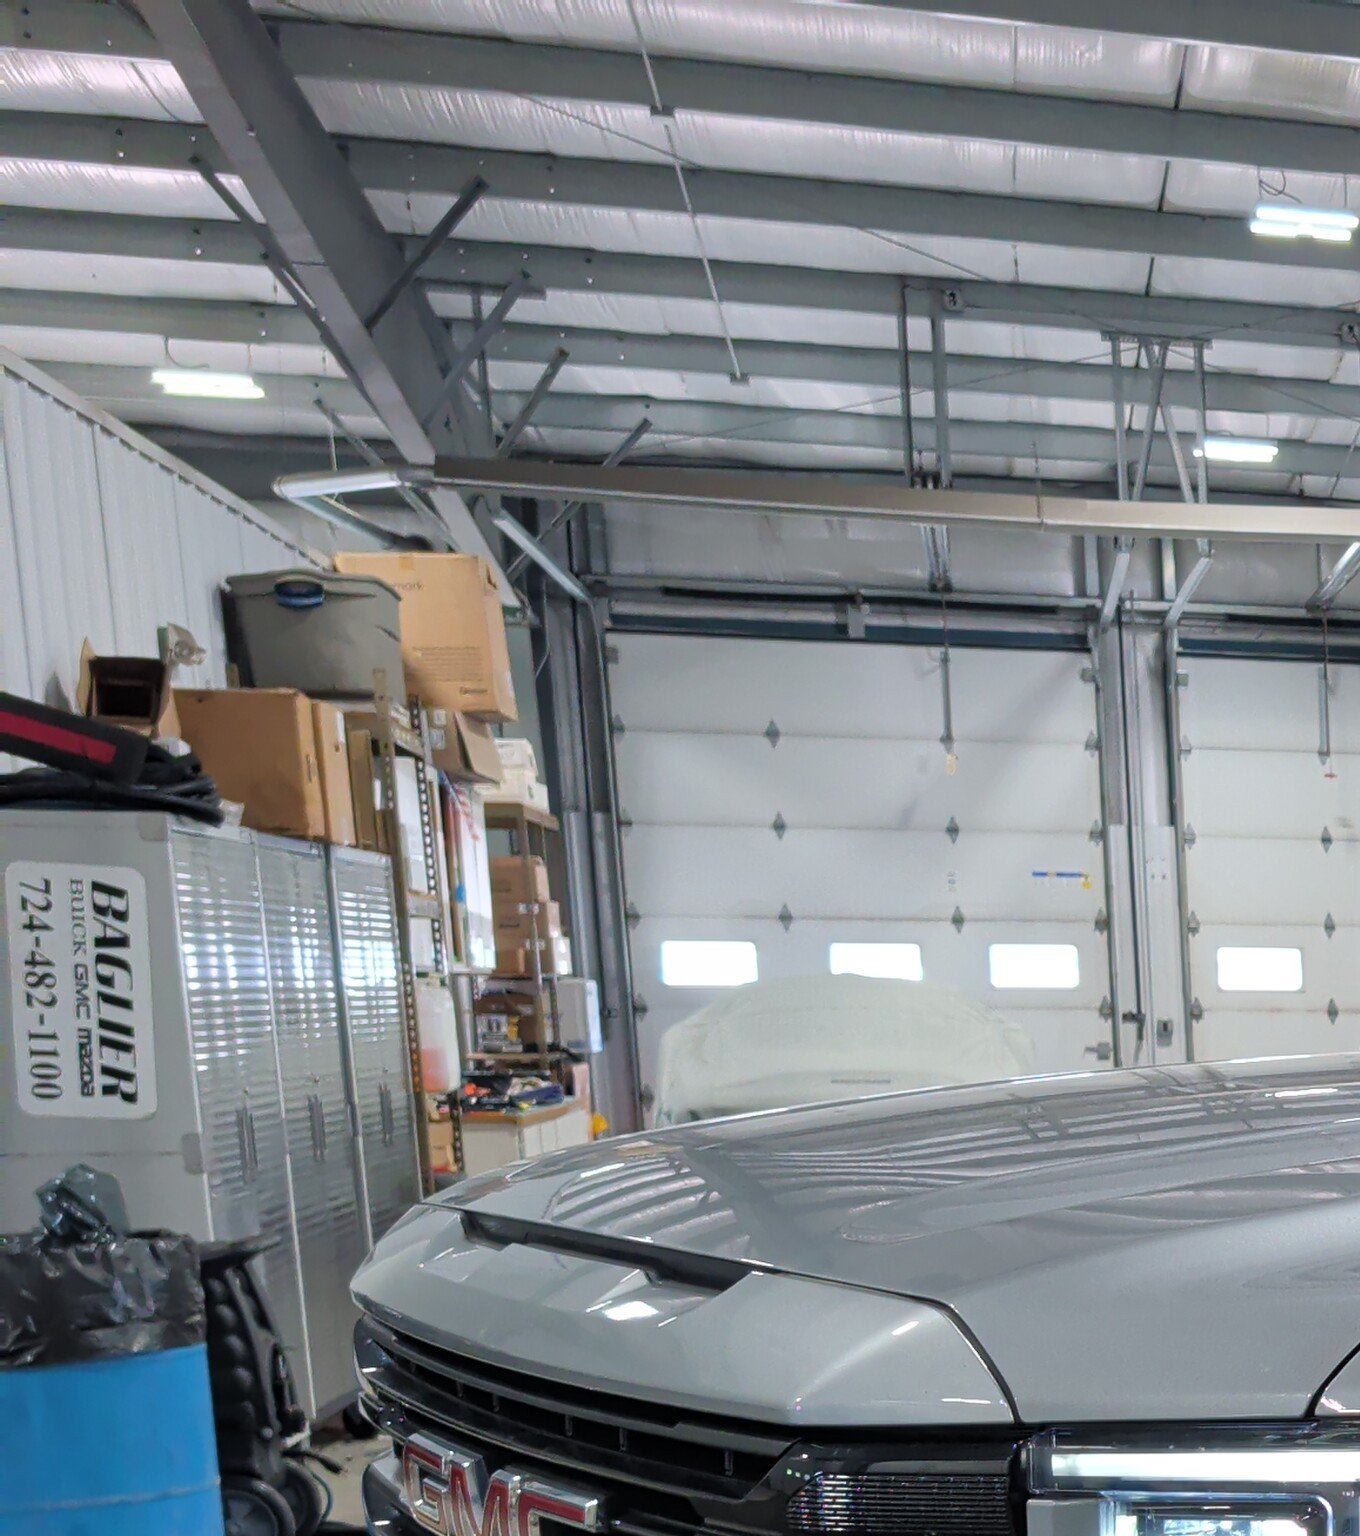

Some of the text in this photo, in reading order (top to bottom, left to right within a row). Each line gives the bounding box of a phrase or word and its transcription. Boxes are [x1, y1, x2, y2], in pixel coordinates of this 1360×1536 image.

[18, 876, 63, 1100] 724-482-1100
[69, 877, 88, 957] BUICK
[73, 963, 91, 1021] GMC
[91, 879, 139, 1106] BAGLIER
